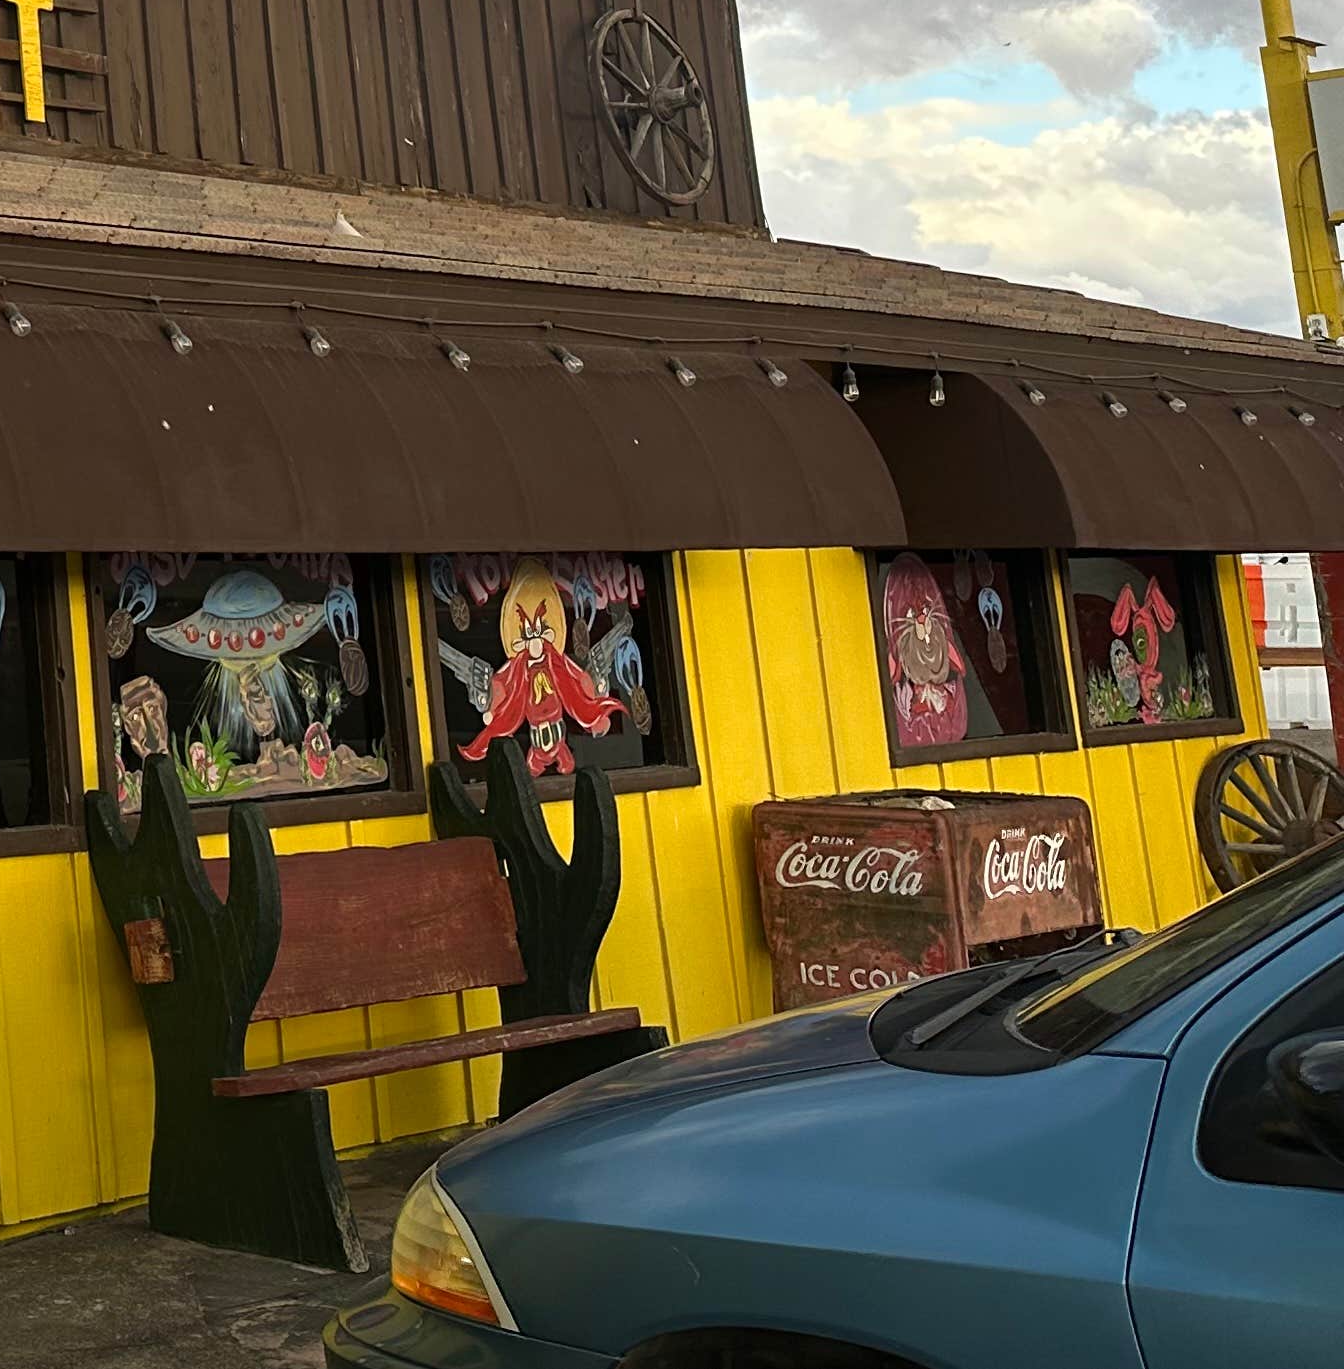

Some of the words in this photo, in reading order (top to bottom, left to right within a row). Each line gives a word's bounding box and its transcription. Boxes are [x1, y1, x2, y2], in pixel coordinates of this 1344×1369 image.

[811, 835, 856, 847] DRINK
[1000, 827, 1026, 840] DRINK
[775, 841, 925, 897] Coca-Cola
[983, 832, 1068, 900] Coca-Cola
[799, 961, 841, 988] ICE
